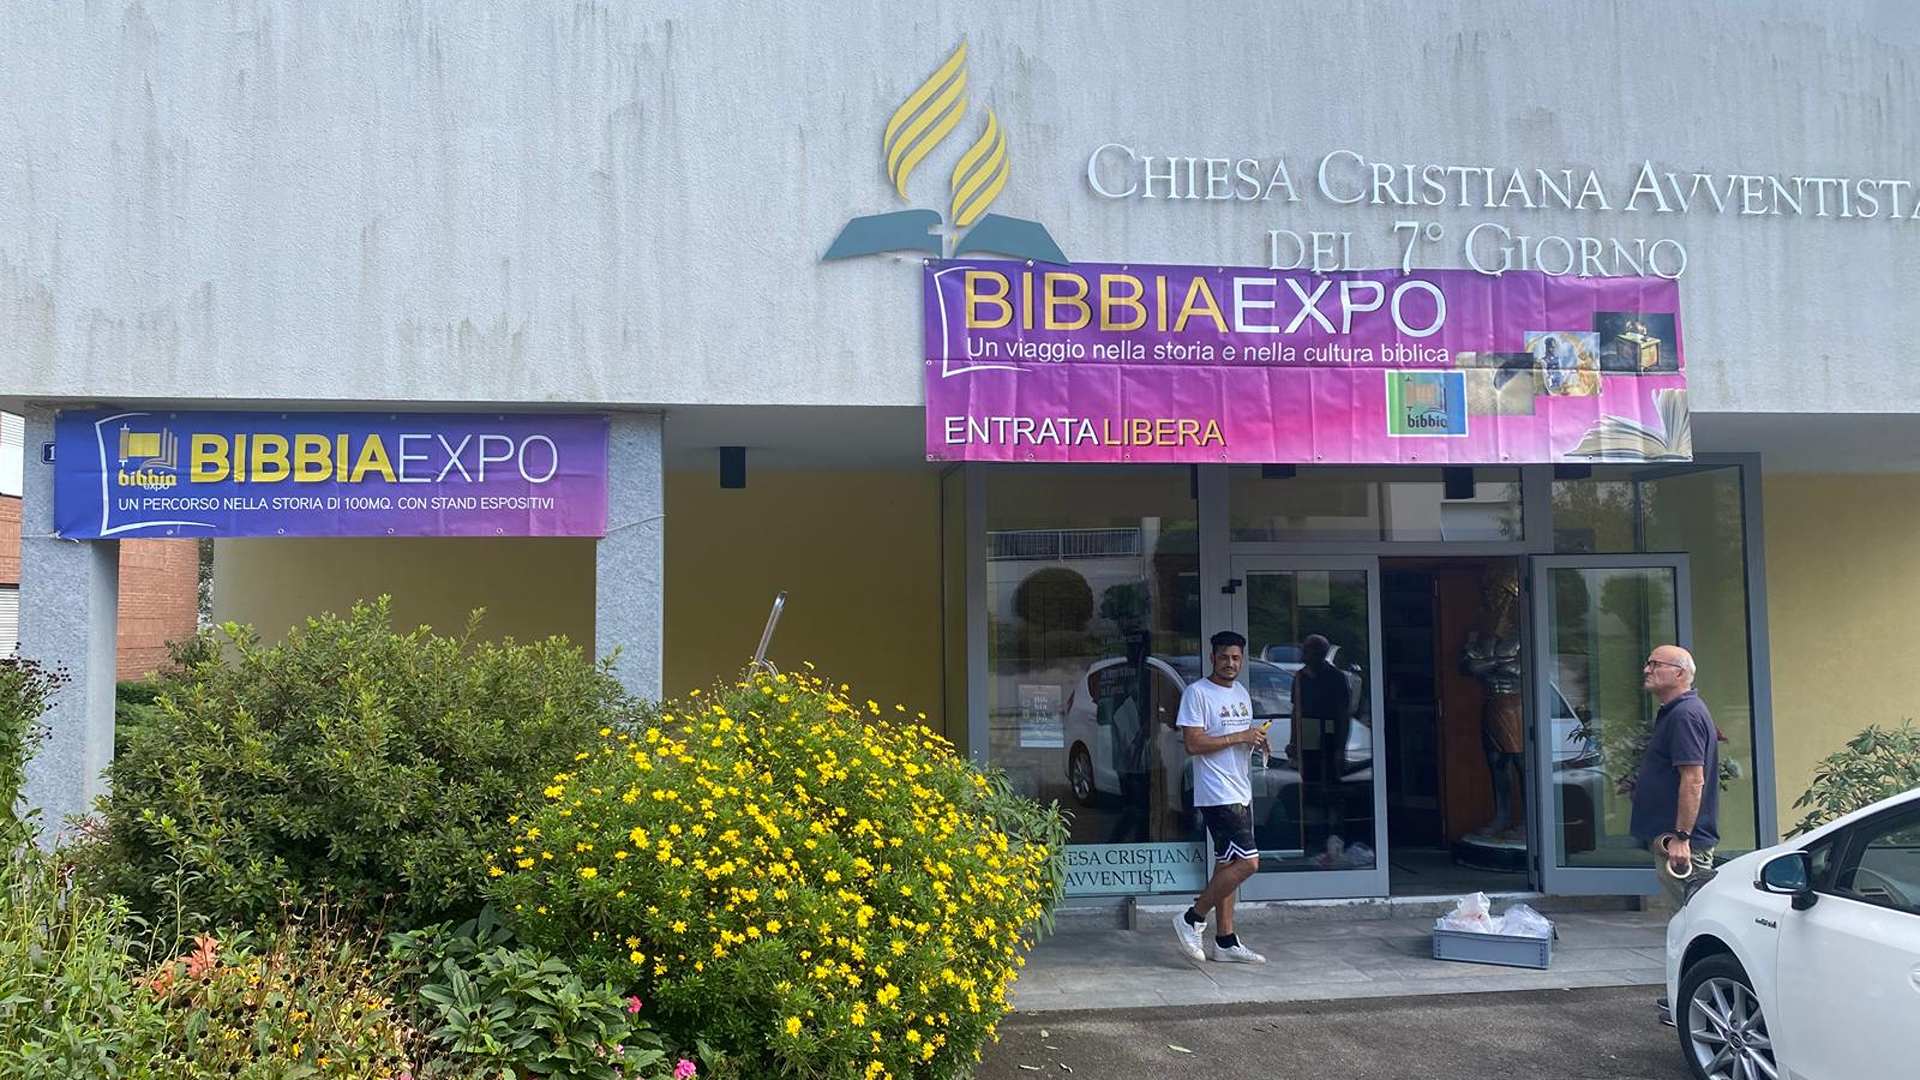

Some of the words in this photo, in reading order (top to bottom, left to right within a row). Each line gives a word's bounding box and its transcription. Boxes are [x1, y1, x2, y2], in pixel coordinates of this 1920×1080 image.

[1087, 143, 1299, 201] CHIESA
[1318, 149, 1613, 211] CRISTIANA
[1268, 229, 1364, 272] DEL
[1465, 222, 1688, 279] GIORNO
[967, 337, 999, 358] Un
[1006, 339, 1085, 363] viaggio
[1093, 341, 1146, 361] nella
[1153, 342, 1214, 363] storia
[1222, 347, 1236, 361] e
[1244, 342, 1296, 362] nella
[1303, 343, 1374, 363] cultura
[1381, 344, 1450, 363] biblica
[118, 498, 139, 511] UN
[143, 498, 220, 511] PERCORSO
[223, 498, 269, 511] NELLA
[272, 498, 324, 511] STORIA
[327, 498, 341, 510] DI
[344, 497, 394, 511] 100MQ.
[397, 497, 427, 510] CON
[431, 497, 477, 510] STAND
[481, 497, 554, 510] ESPOSITIVI
[1064, 850, 1101, 866] ESA
[1105, 848, 1204, 866] CRISTIANA
[1064, 869, 1176, 887] AVVENTISTA
